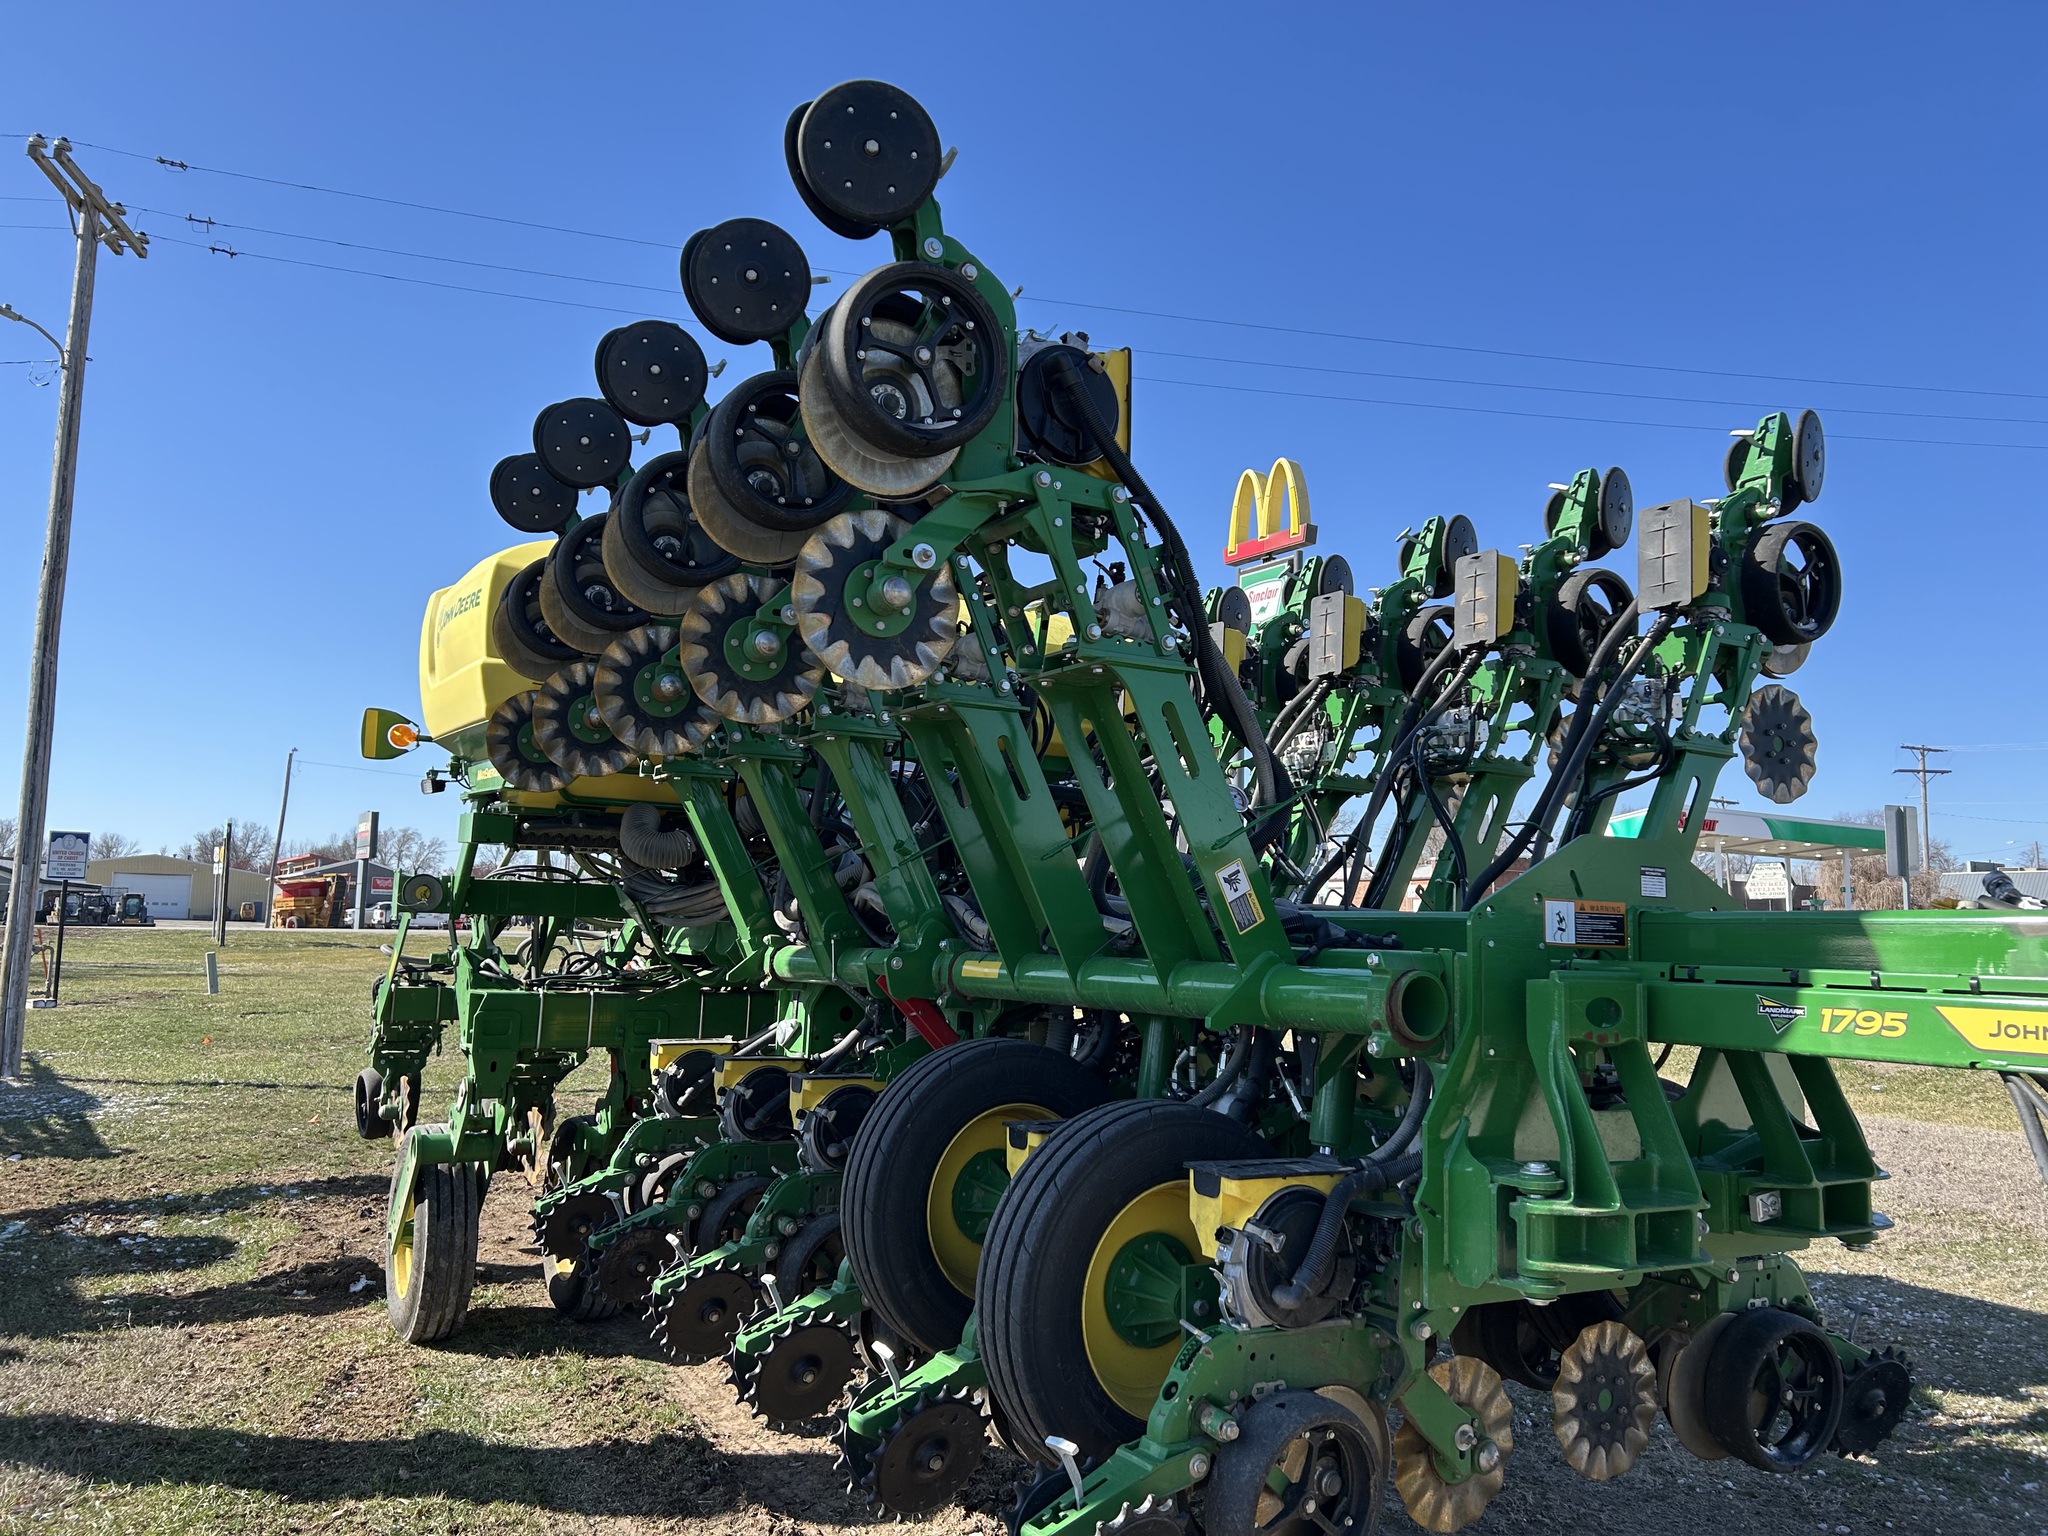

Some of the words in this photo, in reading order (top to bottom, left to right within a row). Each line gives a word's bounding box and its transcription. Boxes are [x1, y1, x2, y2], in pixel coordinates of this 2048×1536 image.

[454, 588, 482, 618] DEERE
[1249, 587, 1279, 603] Sinclair
[1250, 898, 1262, 920] CAUTION
[1590, 905, 1621, 913] WARNING
[1820, 1007, 1908, 1038] 1795
